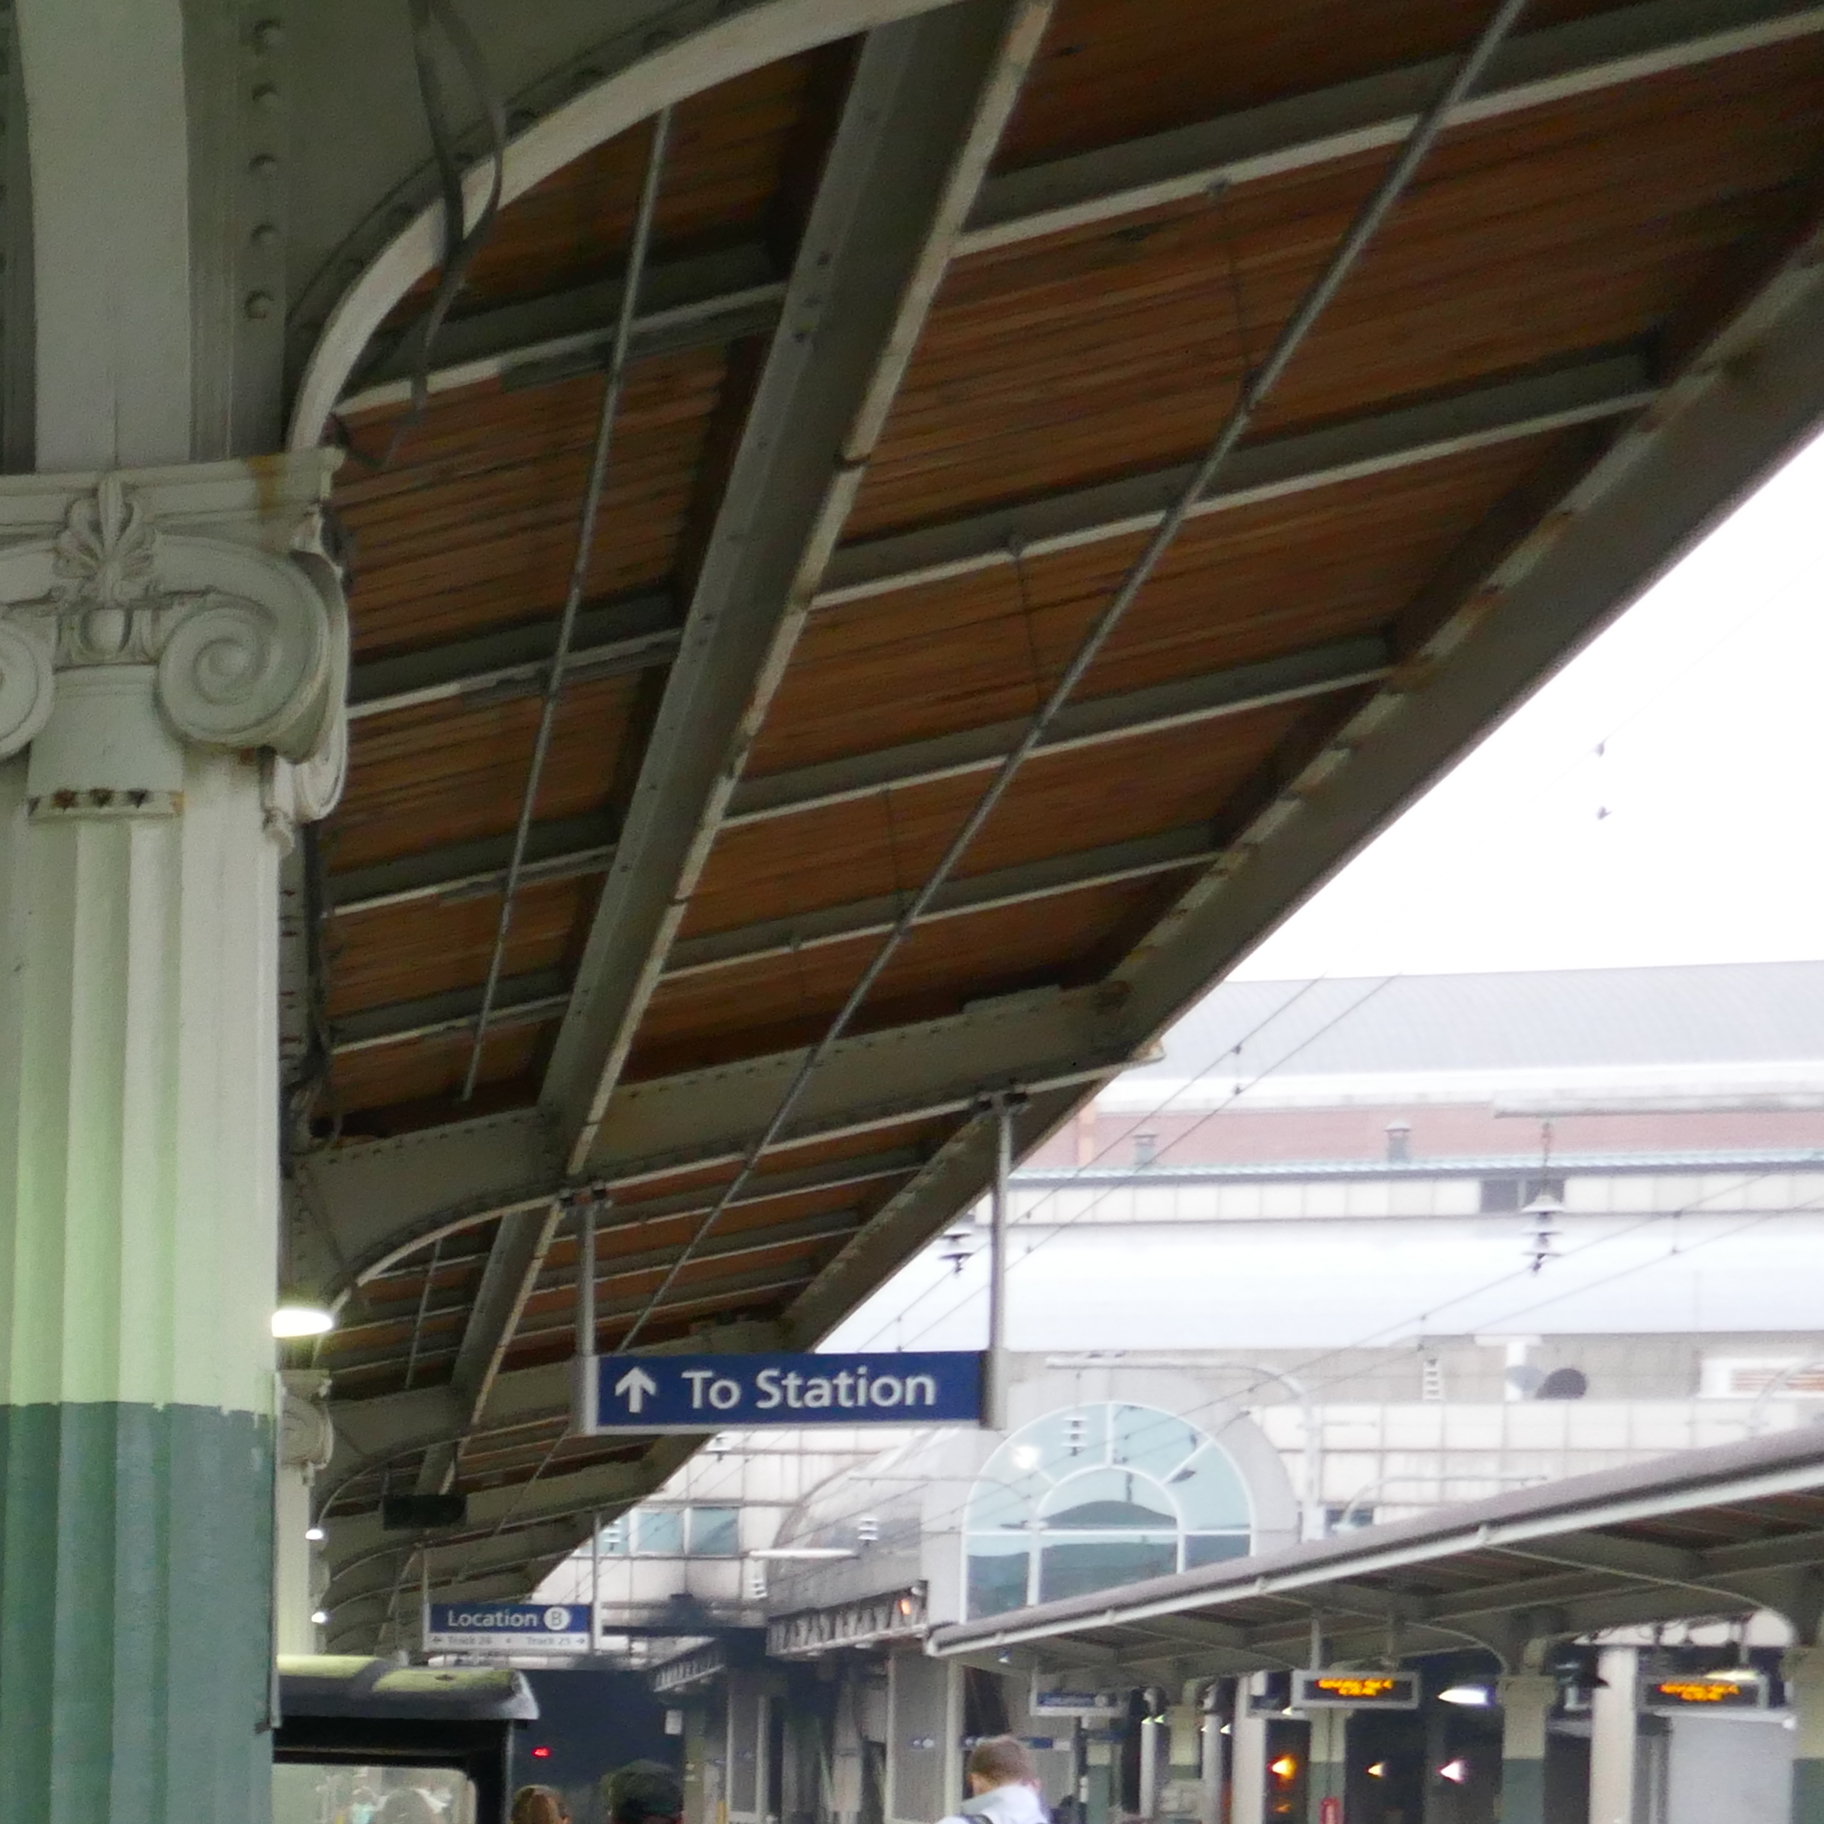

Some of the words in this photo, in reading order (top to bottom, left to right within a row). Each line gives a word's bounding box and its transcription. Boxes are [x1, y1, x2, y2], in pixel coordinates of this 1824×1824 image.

[681, 1370, 741, 1410] To
[755, 1366, 937, 1410] Station
[447, 1609, 538, 1627] Location
